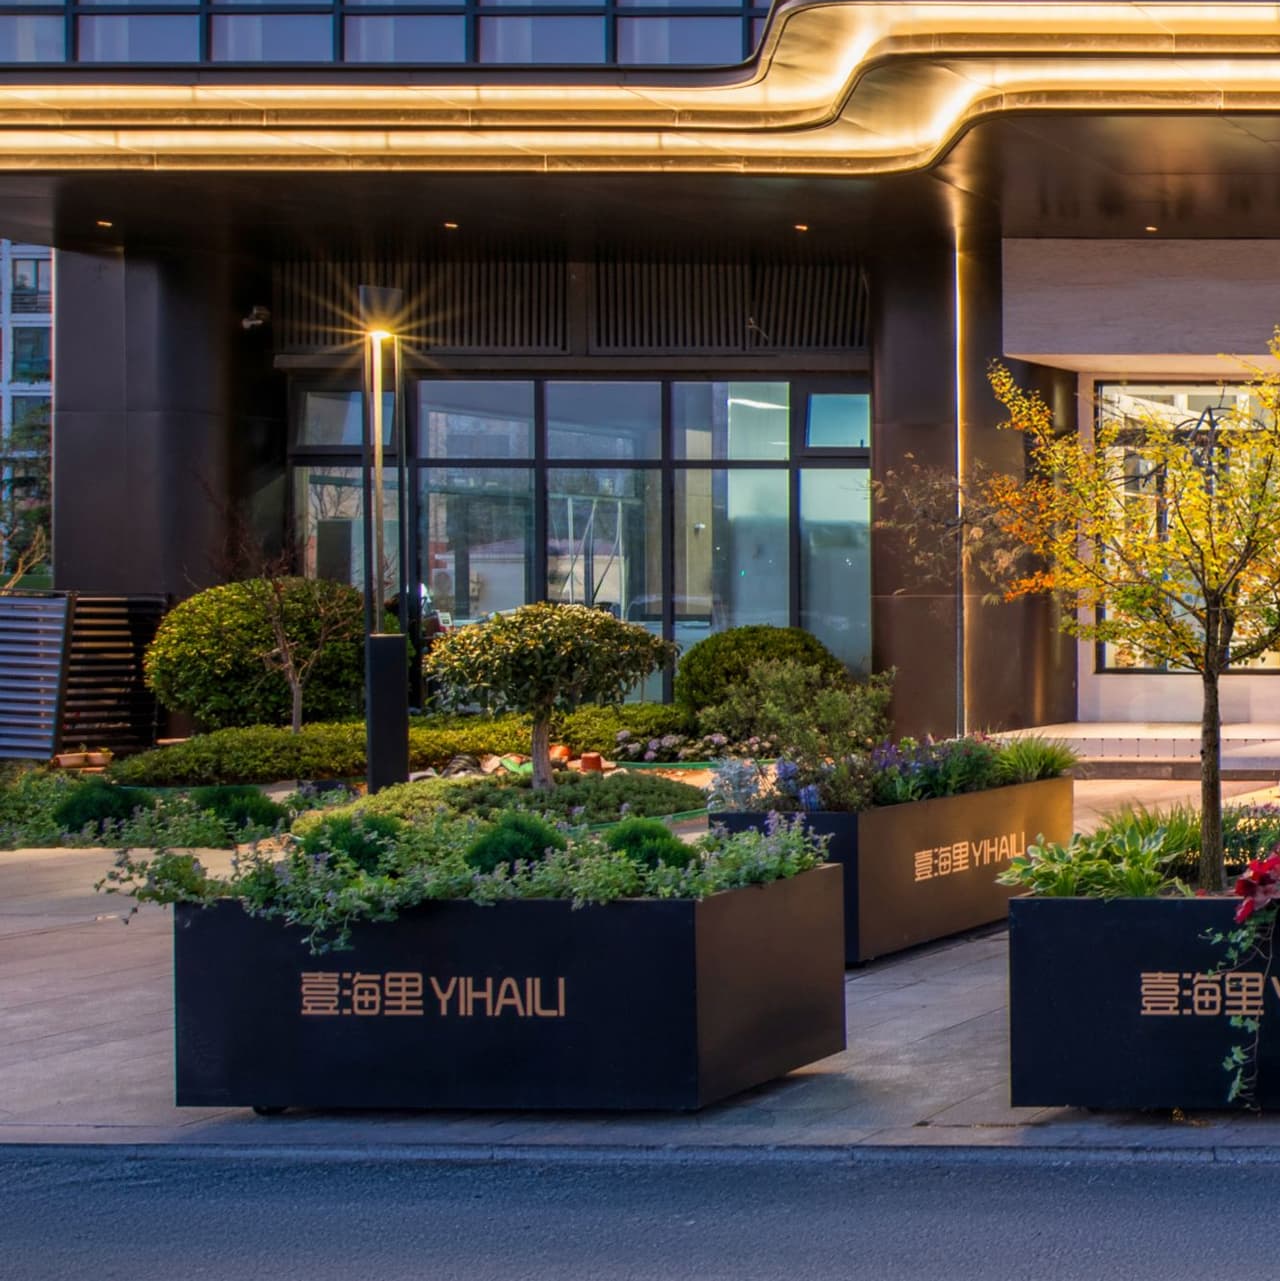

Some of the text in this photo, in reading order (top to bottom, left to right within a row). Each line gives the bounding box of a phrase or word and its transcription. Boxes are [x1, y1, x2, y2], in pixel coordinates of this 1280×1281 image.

[914, 840, 969, 882] 壹海里
[301, 972, 566, 1017] 壹海里 YIHAILI
[1140, 972, 1265, 1016] 壹海里
